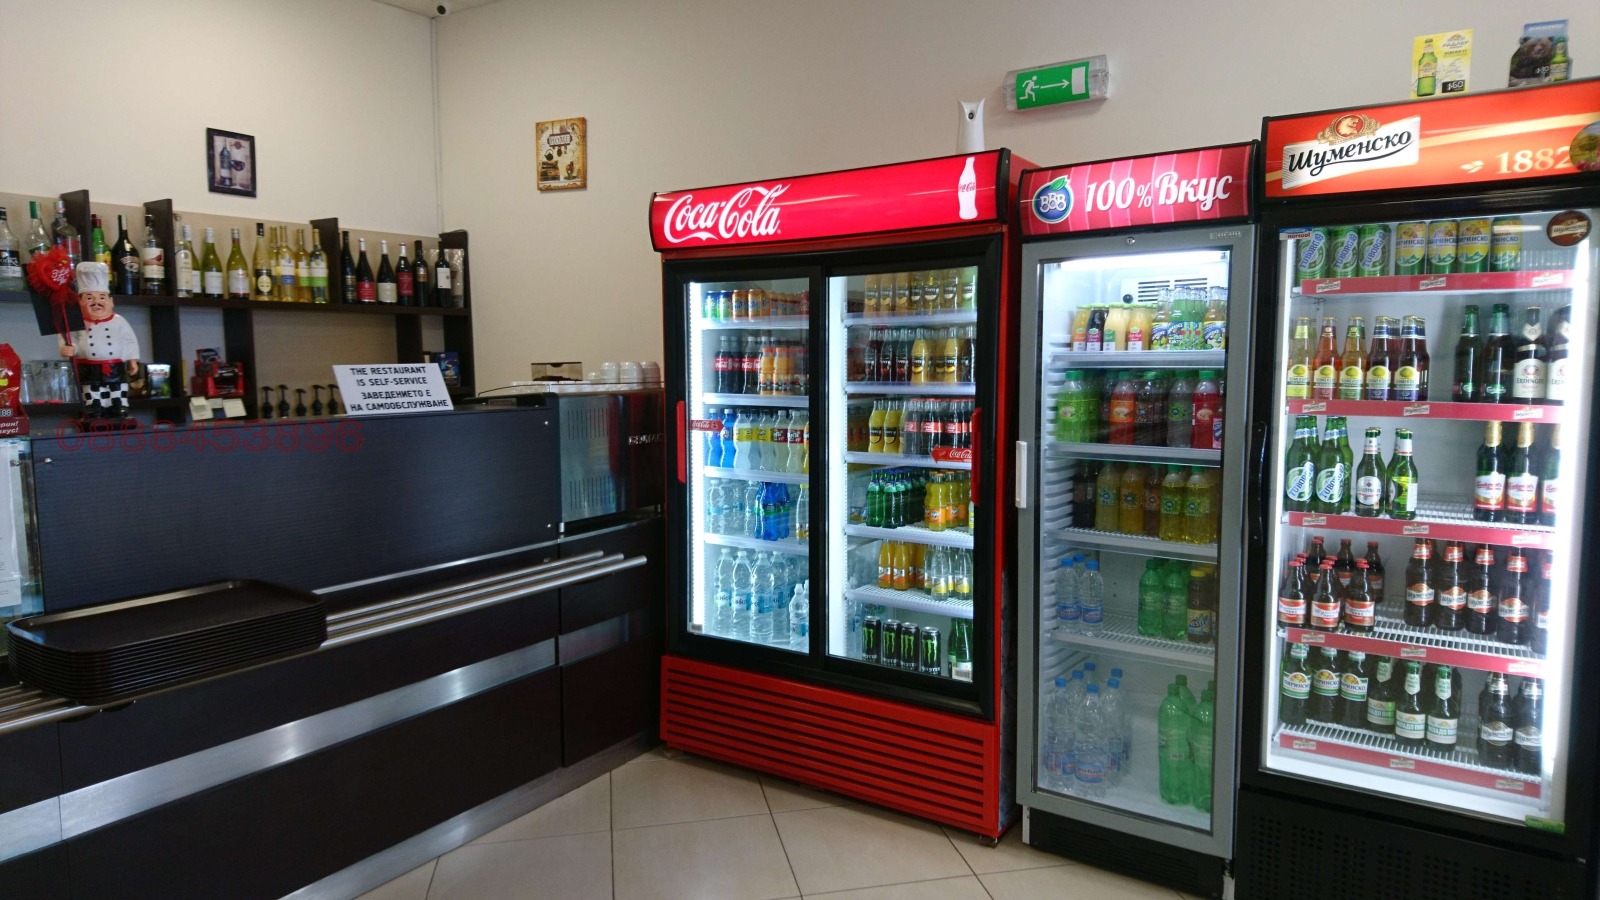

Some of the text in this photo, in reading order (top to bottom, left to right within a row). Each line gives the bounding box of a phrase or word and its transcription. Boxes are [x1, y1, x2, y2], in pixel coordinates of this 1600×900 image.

[1287, 130, 1412, 177] Шуменско
[1495, 145, 1571, 175] 1882
[1086, 171, 1233, 213] 100% Вкус
[663, 183, 792, 244] Coca-Cola
[1299, 239, 1319, 269] TUBORG
[1335, 240, 1355, 269] TUBORG
[1362, 239, 1384, 267] TUBORG
[350, 366, 426, 376] THE RESTAURANT
[356, 376, 428, 387] IS SELF-SERVICE
[350, 399, 449, 412] НА САМООБСЛУЖВАНЕ
[361, 389, 432, 400] ЗАВЕДЕНИЕТО Е
